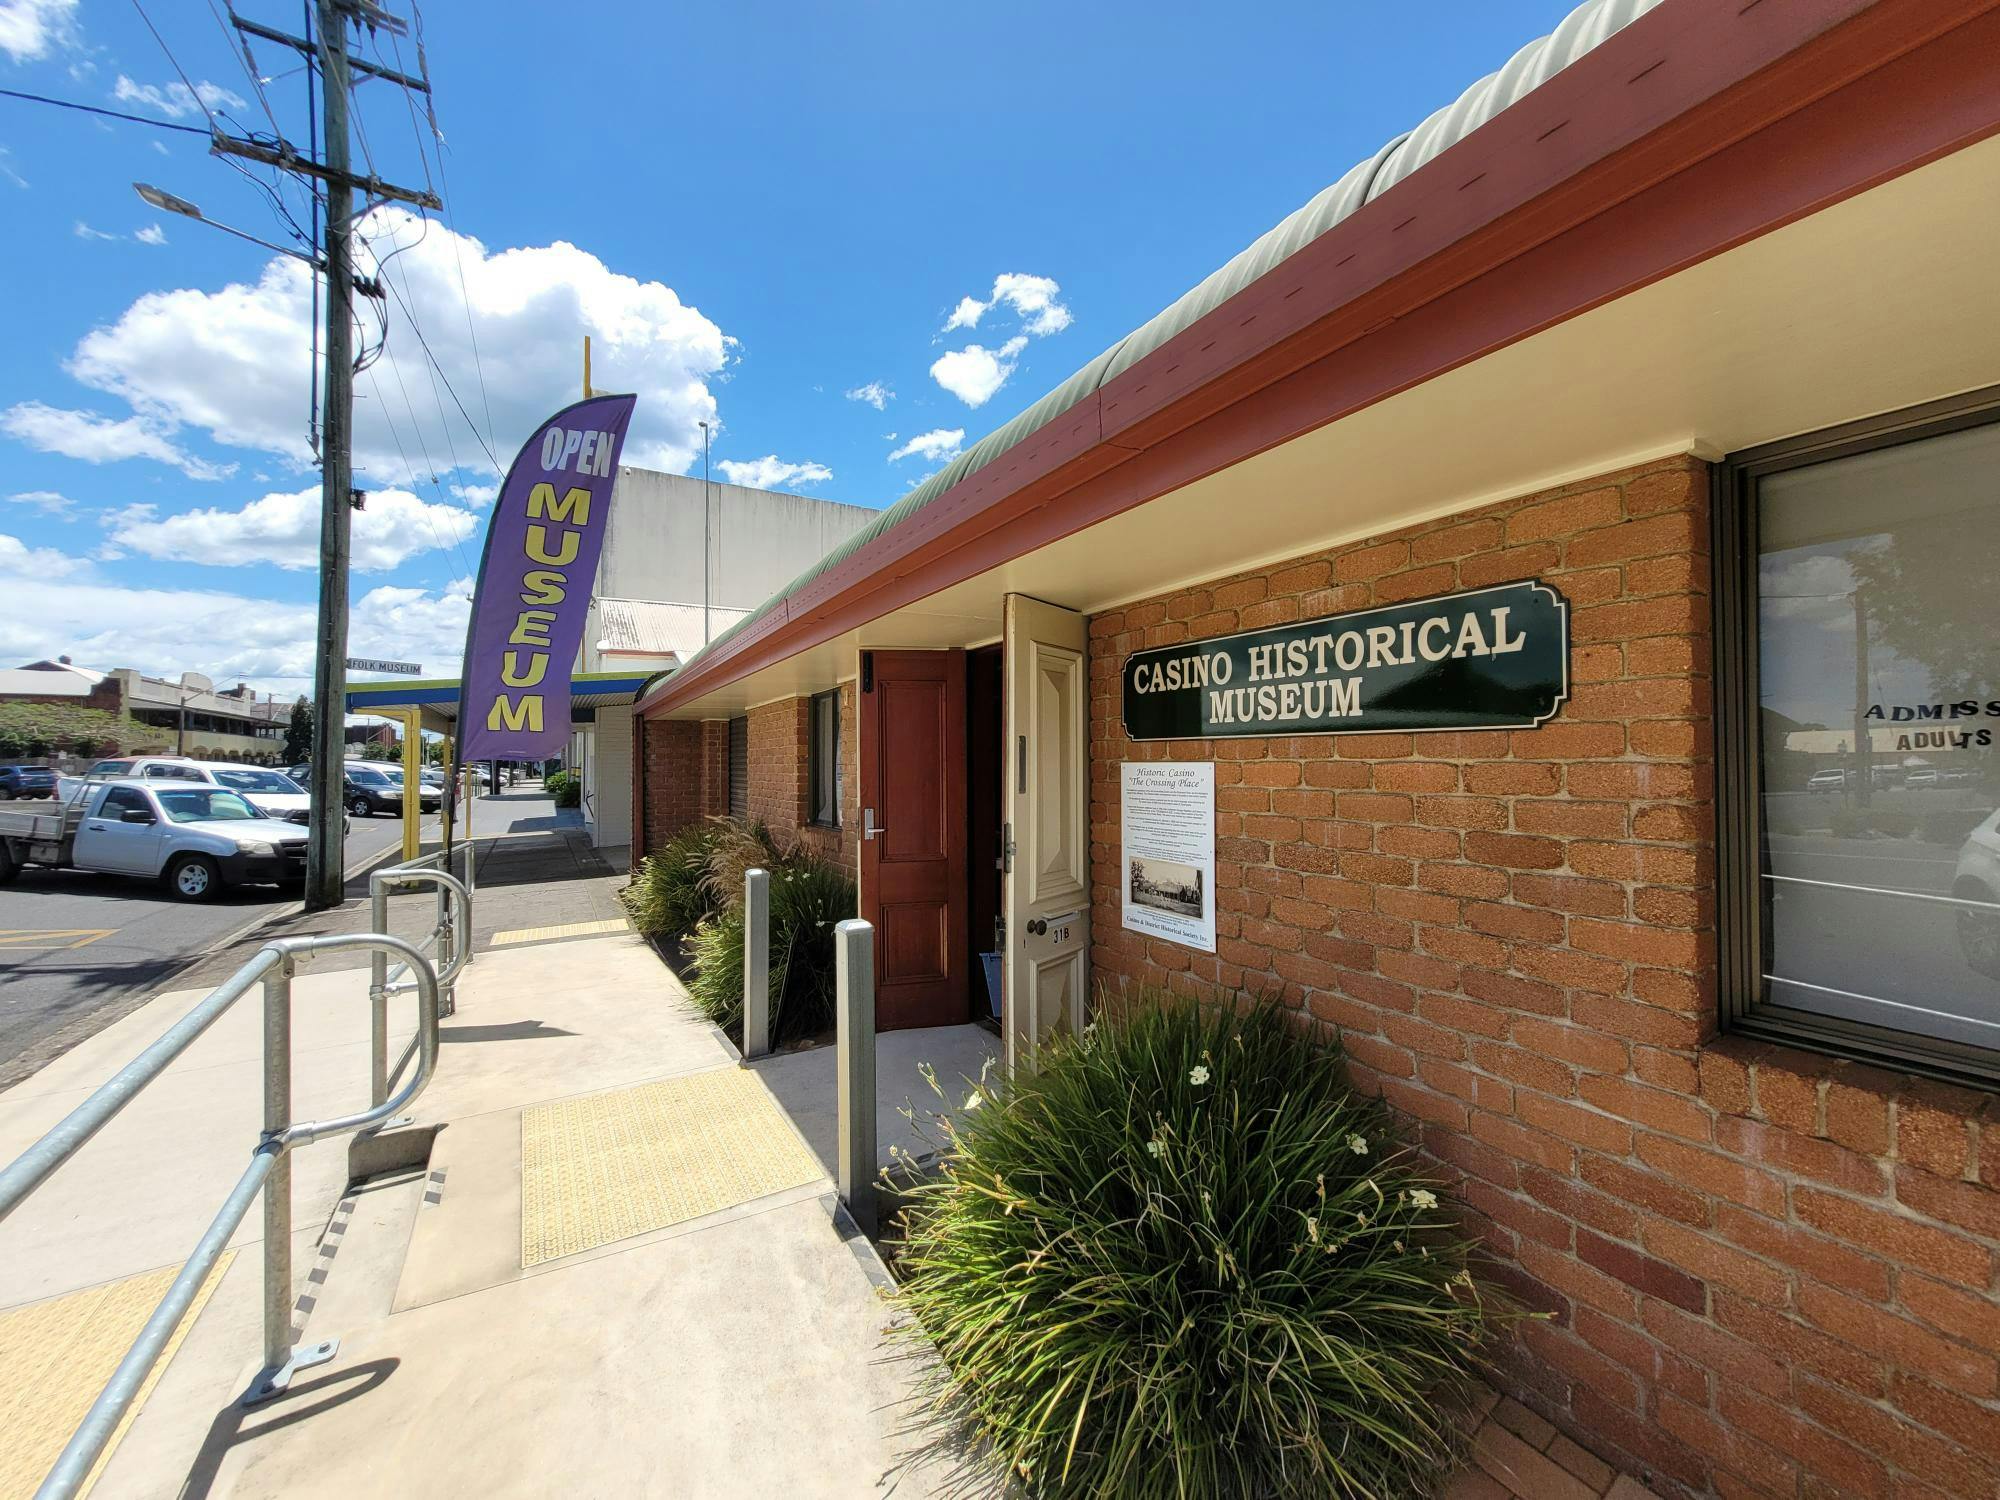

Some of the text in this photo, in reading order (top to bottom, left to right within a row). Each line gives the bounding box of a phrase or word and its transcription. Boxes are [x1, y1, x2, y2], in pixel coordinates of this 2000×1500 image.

[540, 426, 615, 478] OPEN
[487, 482, 593, 733] MUSEUM
[1133, 606, 1527, 694] CASINO HISTORICAL
[352, 660, 421, 674] FOLK MUSEUM
[1209, 677, 1363, 725] MUSEUM
[1864, 700, 2000, 721] ADMISS
[1896, 729, 1992, 750] ADULTS
[1136, 767, 1195, 778] Historic Casino
[1146, 777, 1176, 790] Crossing
[1126, 915, 1140, 925] Casino
[1145, 920, 1160, 930] District
[1161, 924, 1182, 935] Historical
[1182, 930, 1199, 941] Society
